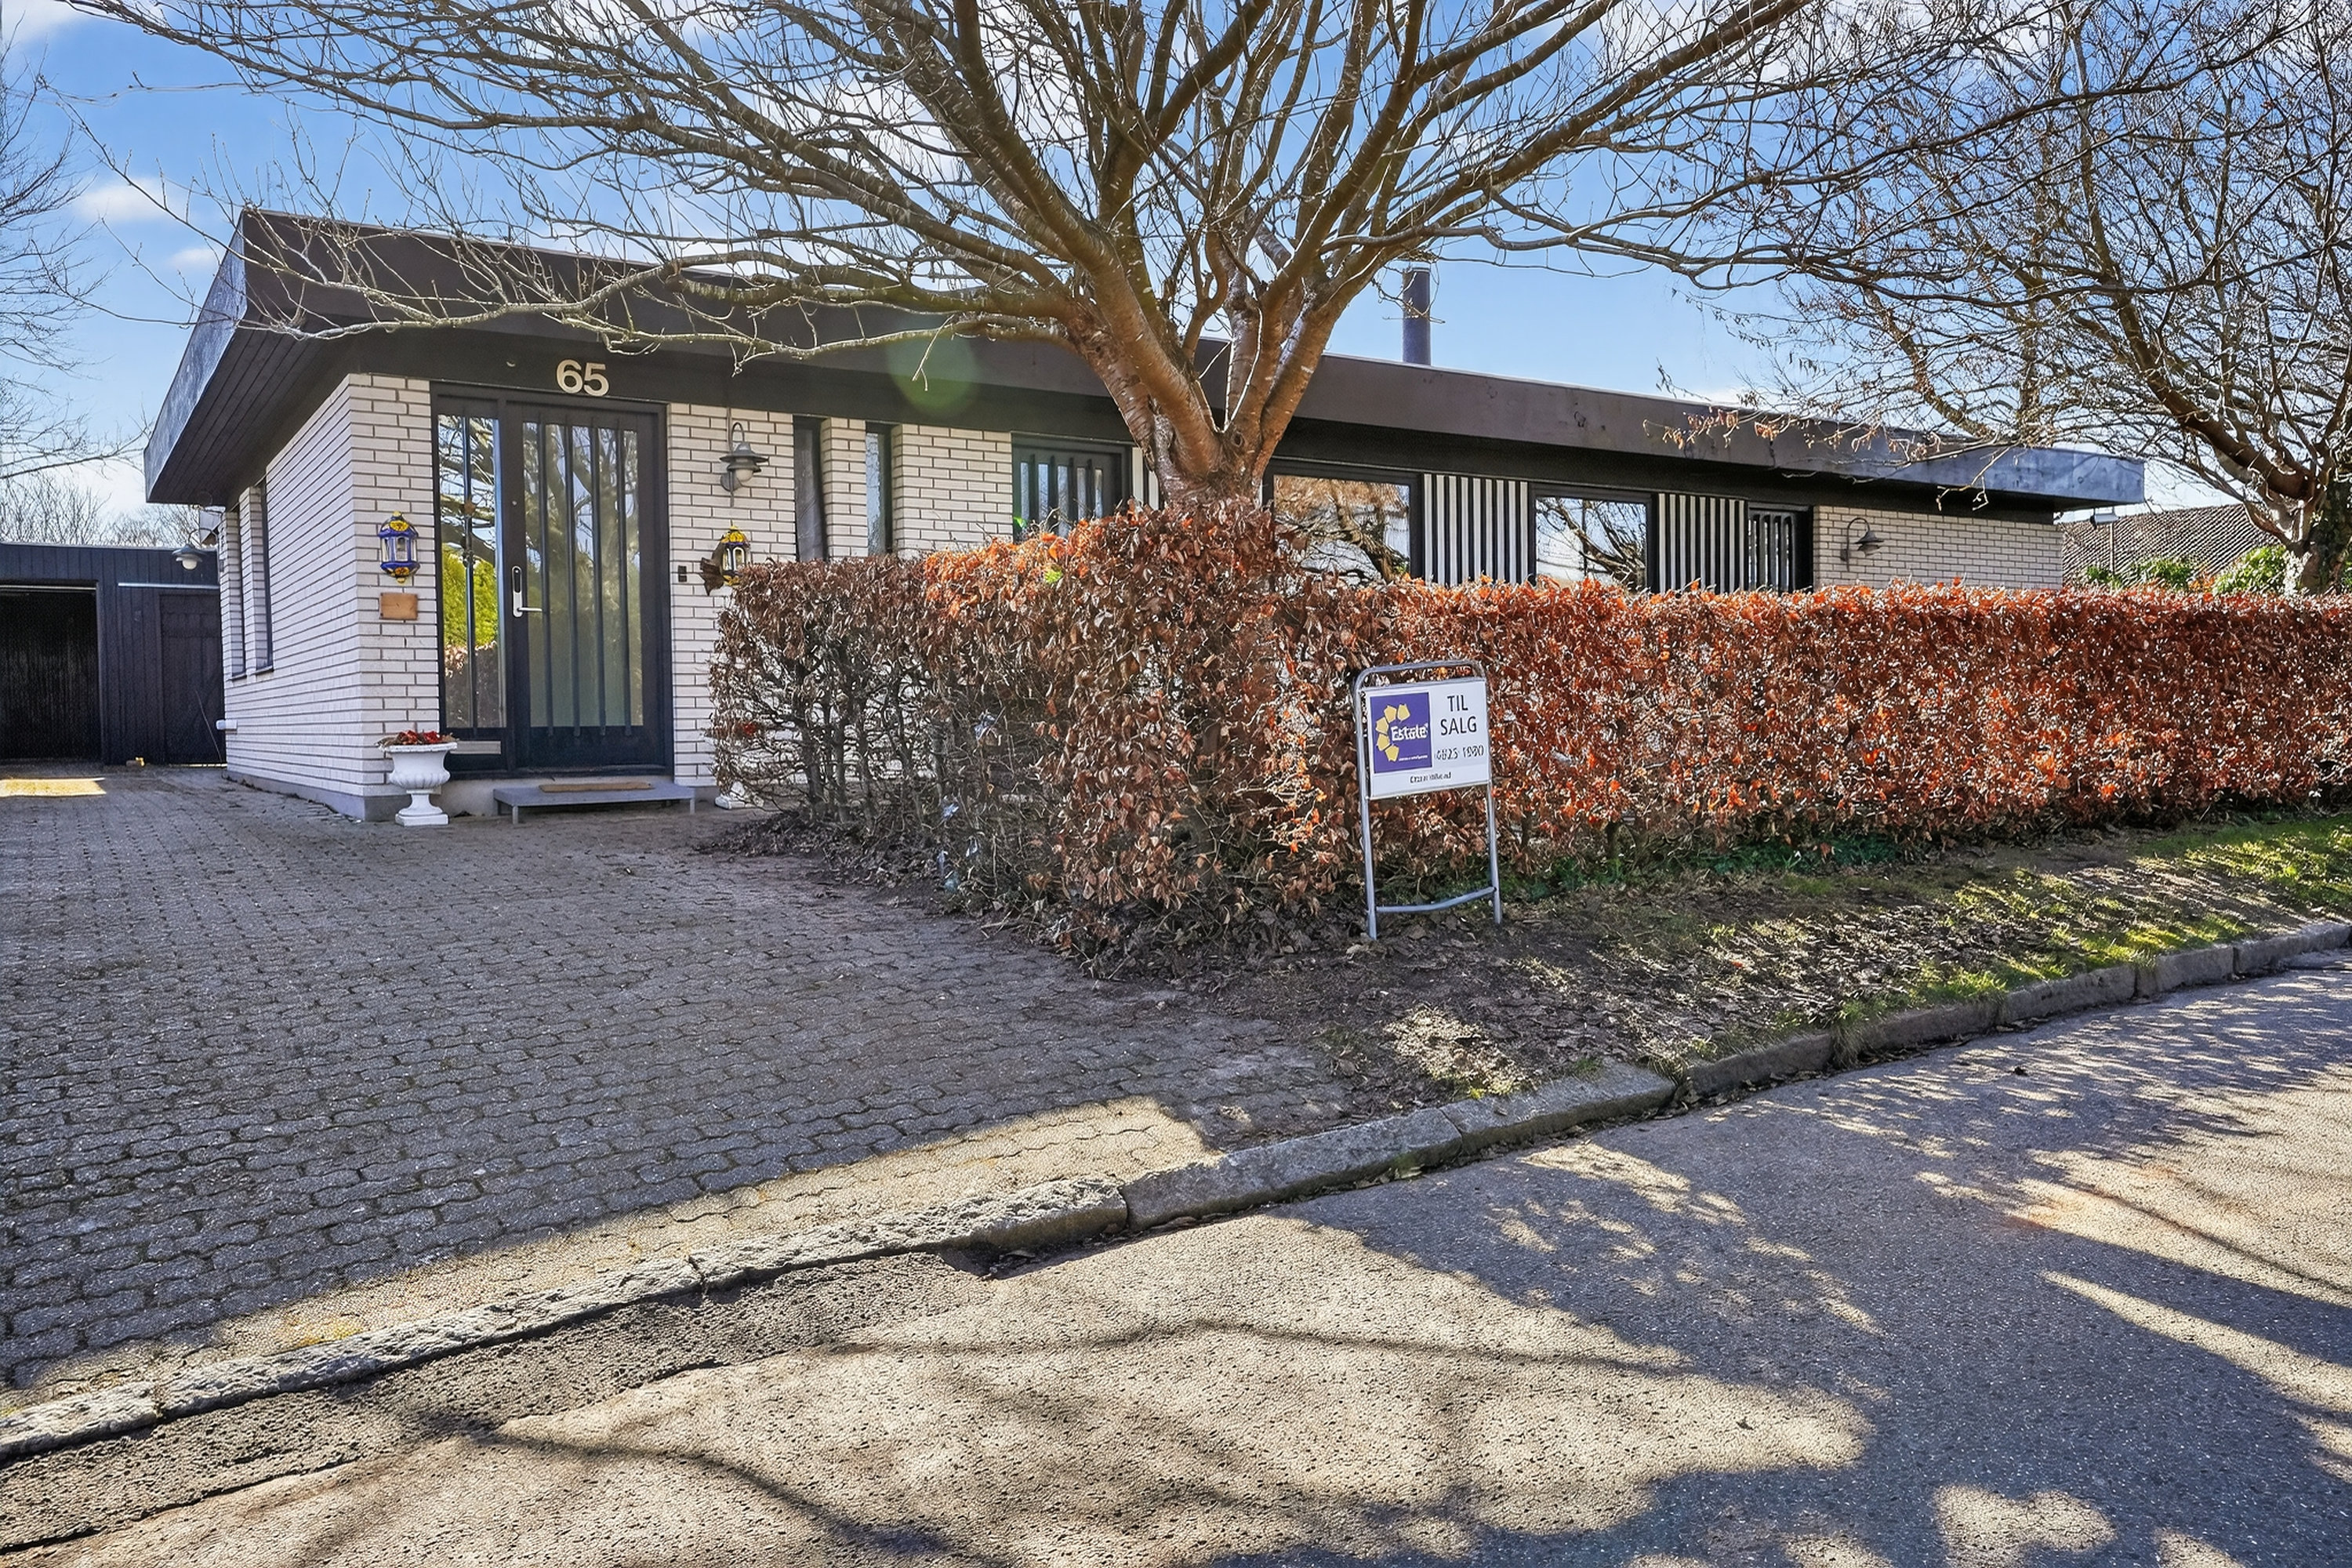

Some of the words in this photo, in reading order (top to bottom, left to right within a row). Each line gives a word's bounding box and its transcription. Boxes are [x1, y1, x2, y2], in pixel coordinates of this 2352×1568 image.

[557, 359, 609, 397] 65
[1447, 695, 1468, 712] TIL
[1391, 724, 1428, 740] Estate
[1440, 716, 1477, 735] SALG
